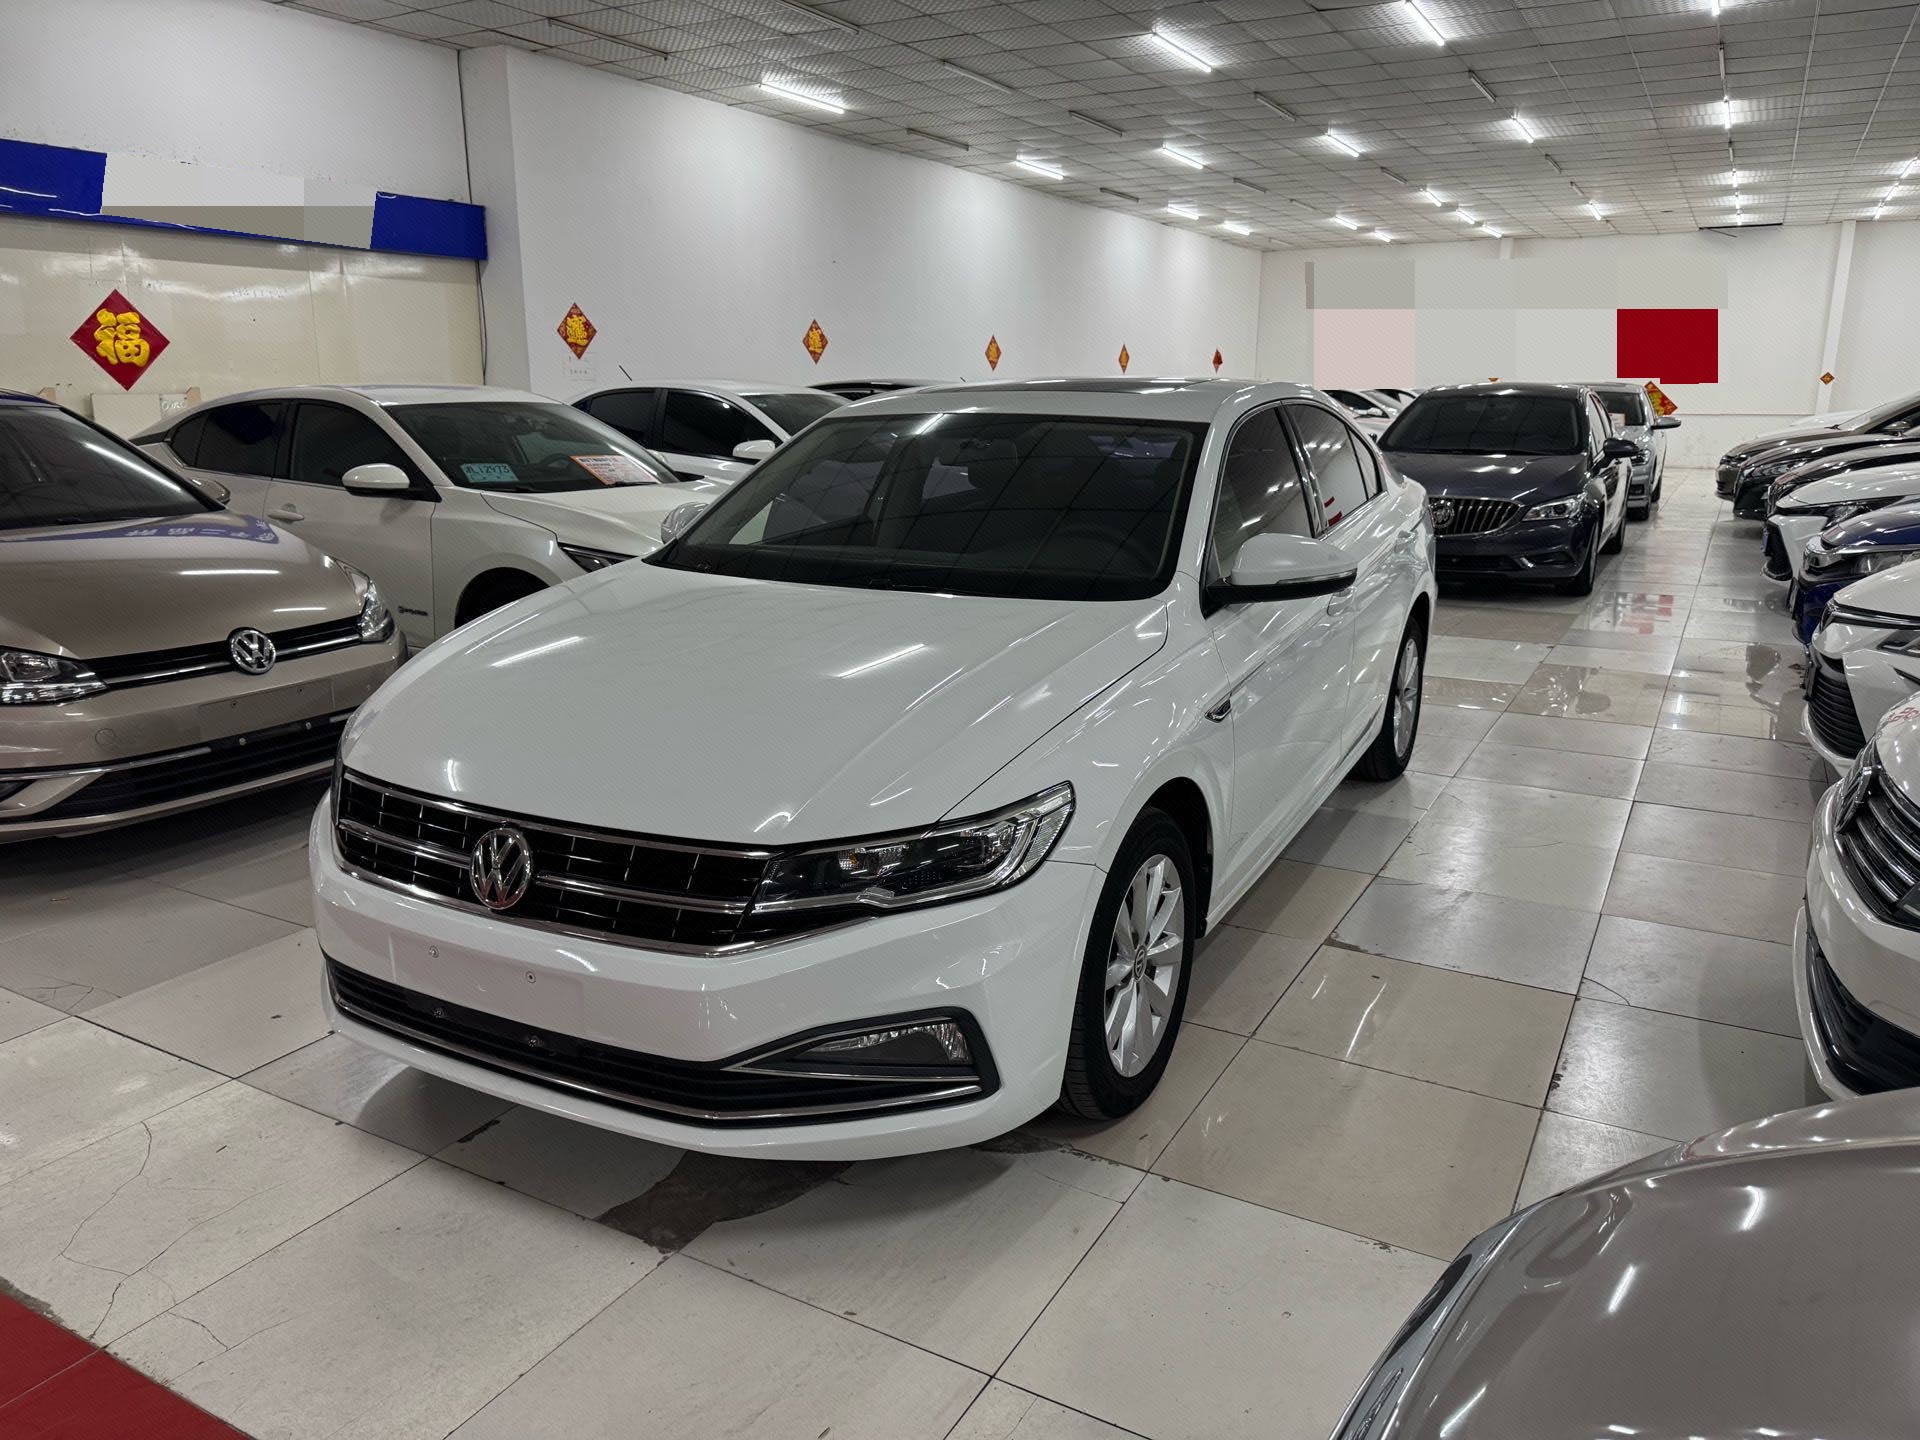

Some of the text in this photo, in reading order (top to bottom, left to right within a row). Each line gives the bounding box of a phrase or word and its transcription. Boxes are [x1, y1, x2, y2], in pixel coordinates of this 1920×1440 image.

[93, 308, 151, 368] 福
[231, 630, 276, 673] VW
[471, 828, 530, 910] VW
